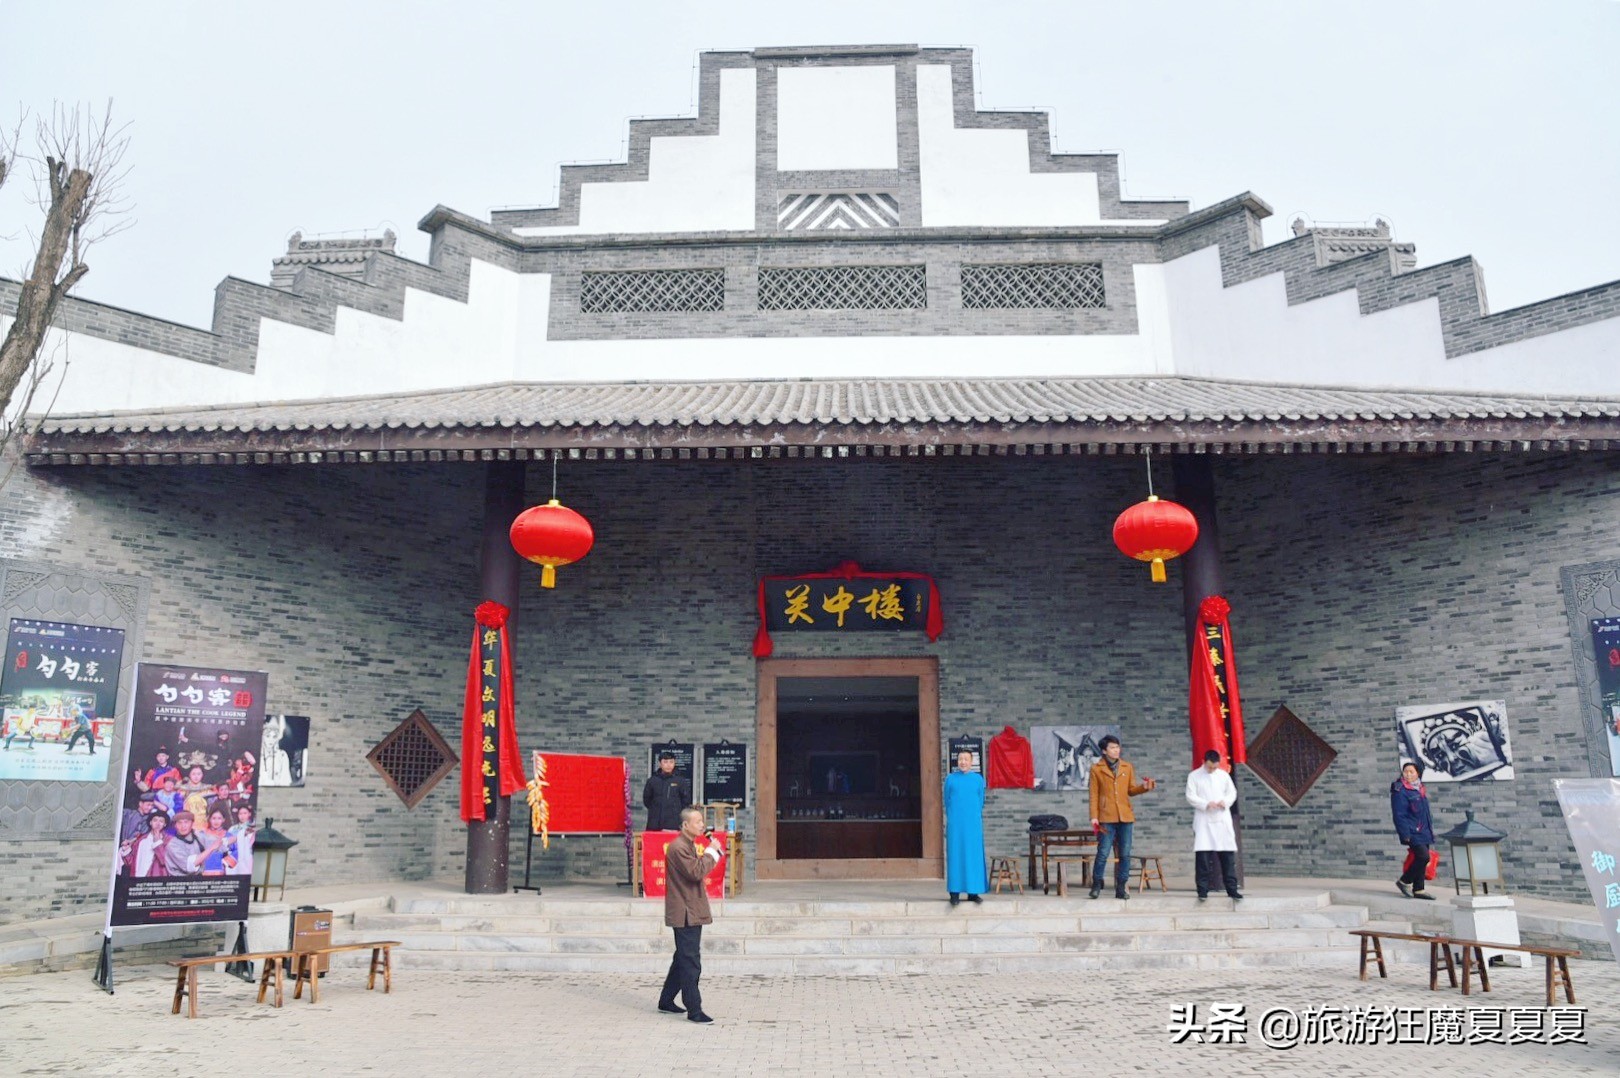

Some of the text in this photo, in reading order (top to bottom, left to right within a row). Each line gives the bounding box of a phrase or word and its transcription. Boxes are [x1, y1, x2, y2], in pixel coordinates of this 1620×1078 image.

[784, 583, 904, 627] 关中楼
[155, 707, 186, 715] LANTIAN
